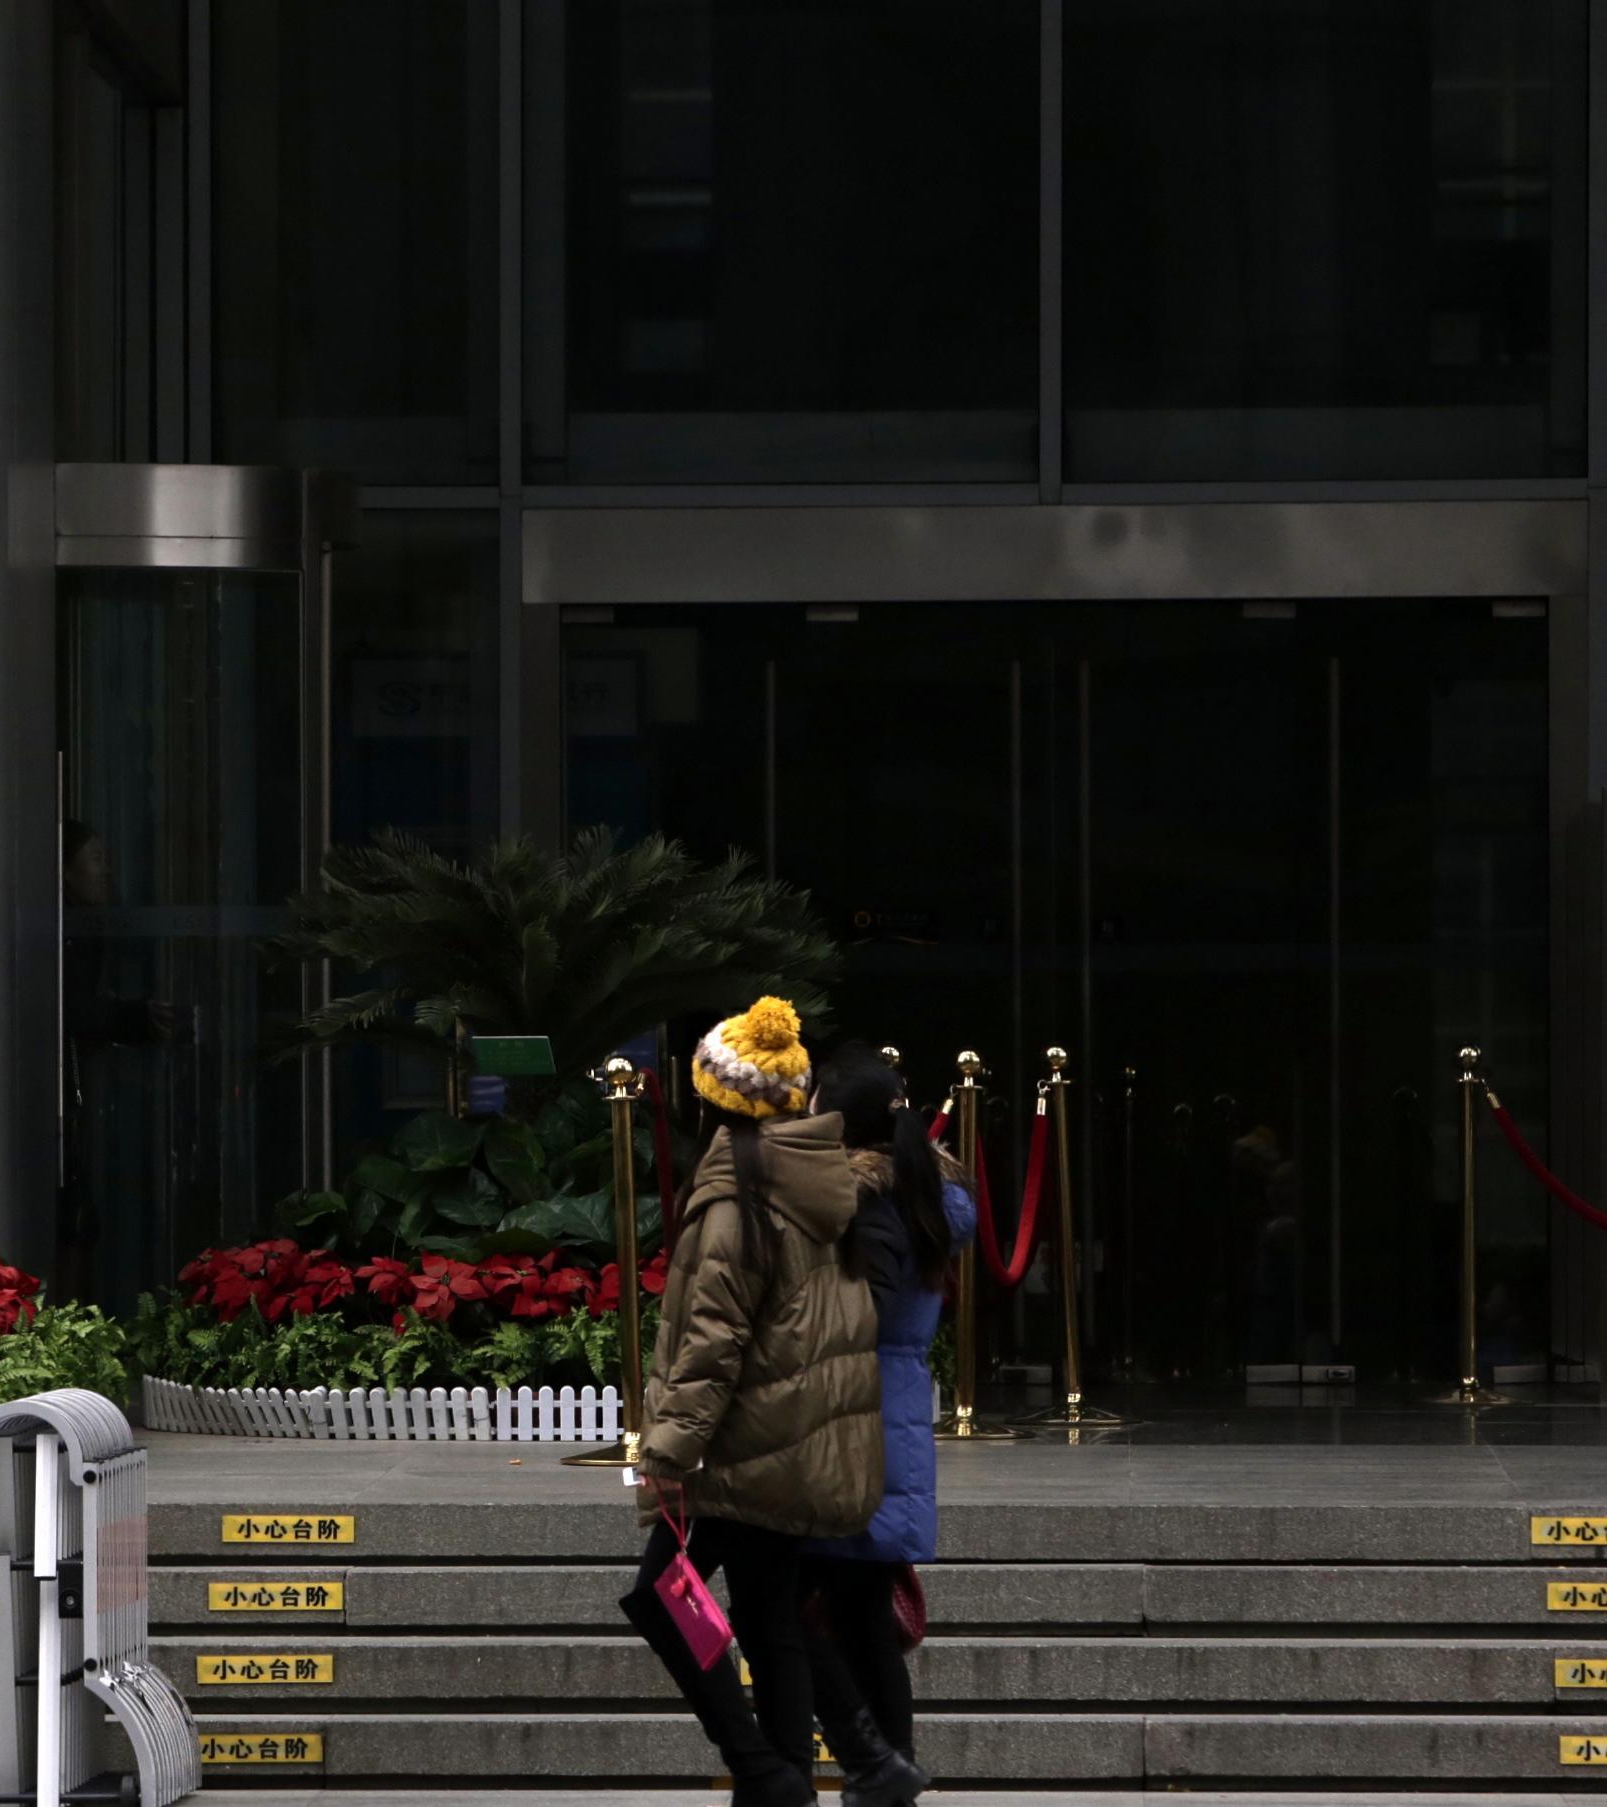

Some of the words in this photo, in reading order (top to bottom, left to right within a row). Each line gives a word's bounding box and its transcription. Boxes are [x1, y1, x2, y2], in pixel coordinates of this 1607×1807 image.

[238, 1519, 340, 1539] 小心台阶
[1547, 1520, 1607, 1541] 小心
[224, 1586, 329, 1607] 小心台阶
[212, 1659, 319, 1680] 小心台阶
[201, 1739, 308, 1759] 小心台阶
[1577, 1740, 1607, 1761] 小
